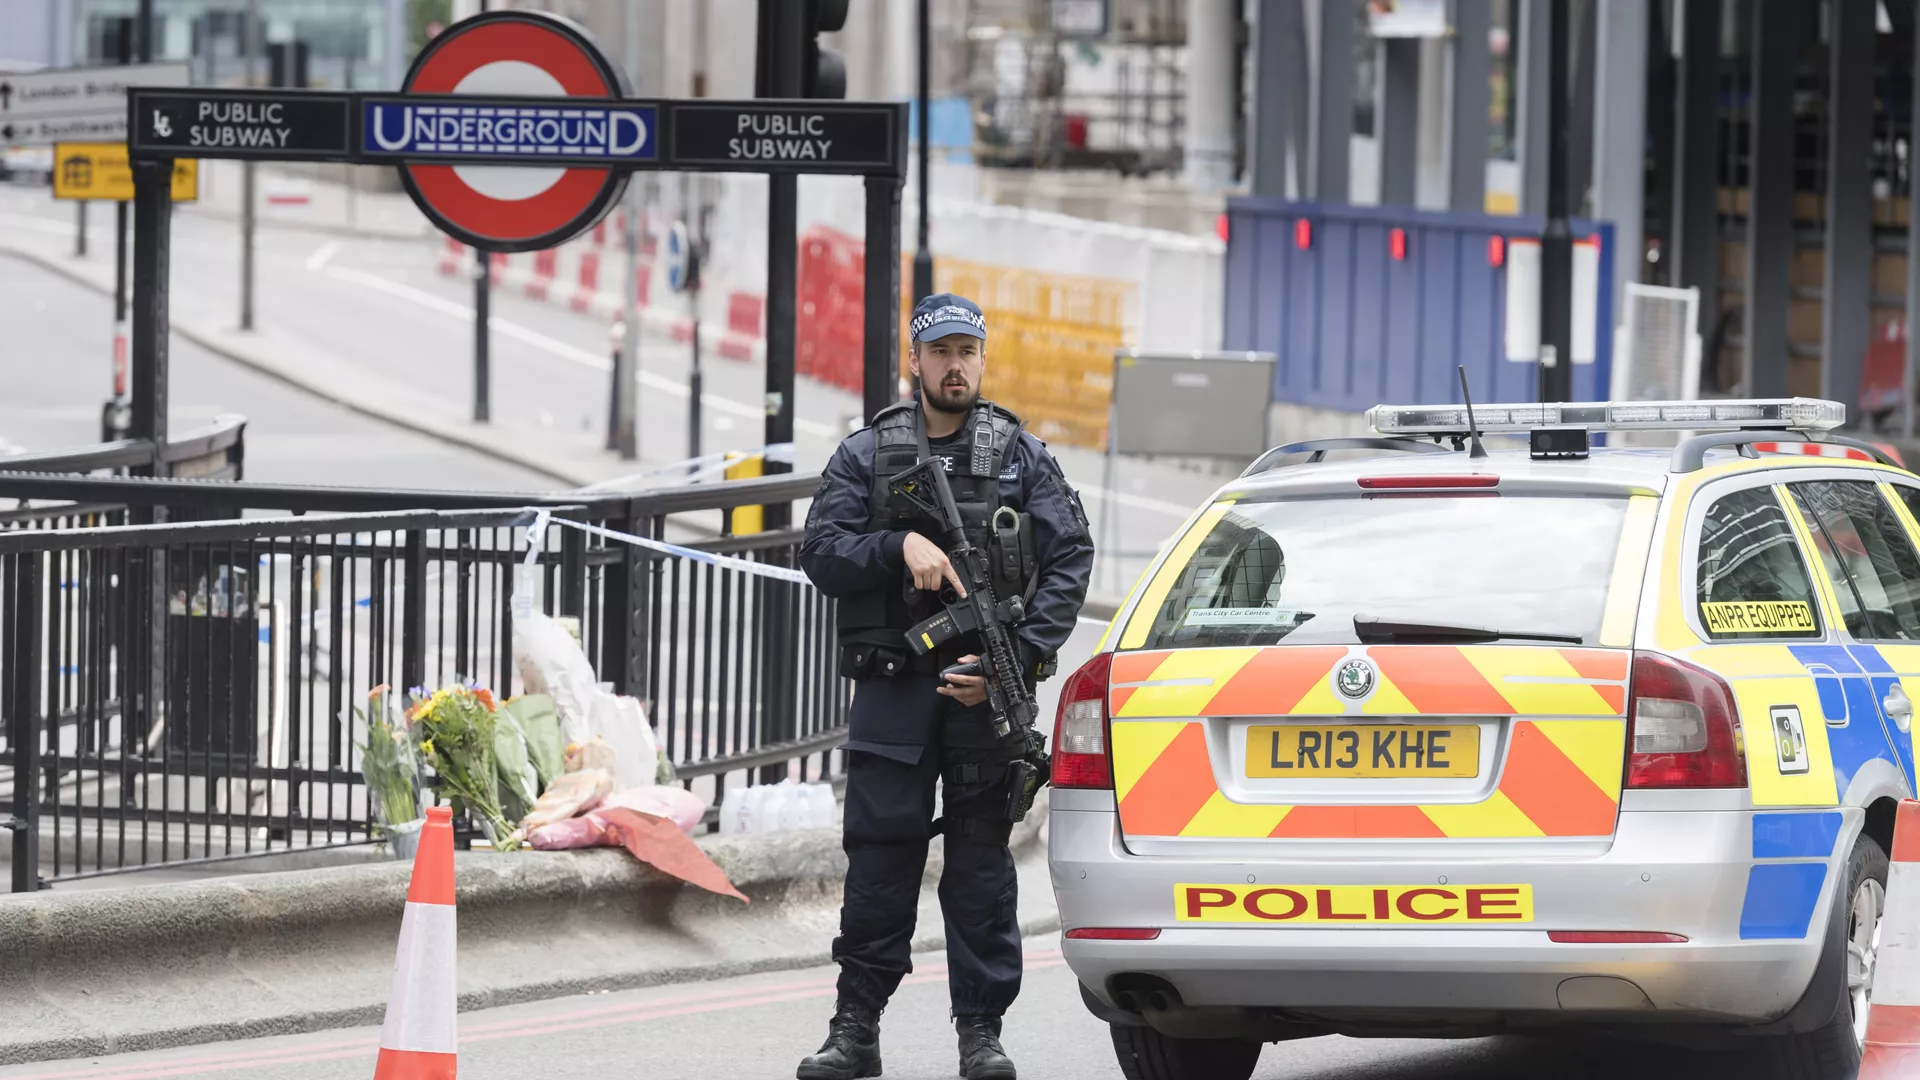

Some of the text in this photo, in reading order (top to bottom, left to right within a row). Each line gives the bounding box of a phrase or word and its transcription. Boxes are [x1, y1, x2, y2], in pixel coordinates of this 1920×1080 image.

[19, 80, 127, 100] London Bridg
[199, 101, 284, 124] PUBLIC
[189, 125, 291, 148] SUBWAY
[373, 106, 648, 155] UNDERGROUND
[737, 114, 825, 136] PUBLIC
[729, 138, 833, 160] SUBWAY
[1213, 610, 1229, 618] City
[1707, 604, 1812, 629] ANPR EQUIPPED
[1270, 730, 1452, 769] LR13 KHE
[1185, 887, 1523, 921] POLICE
